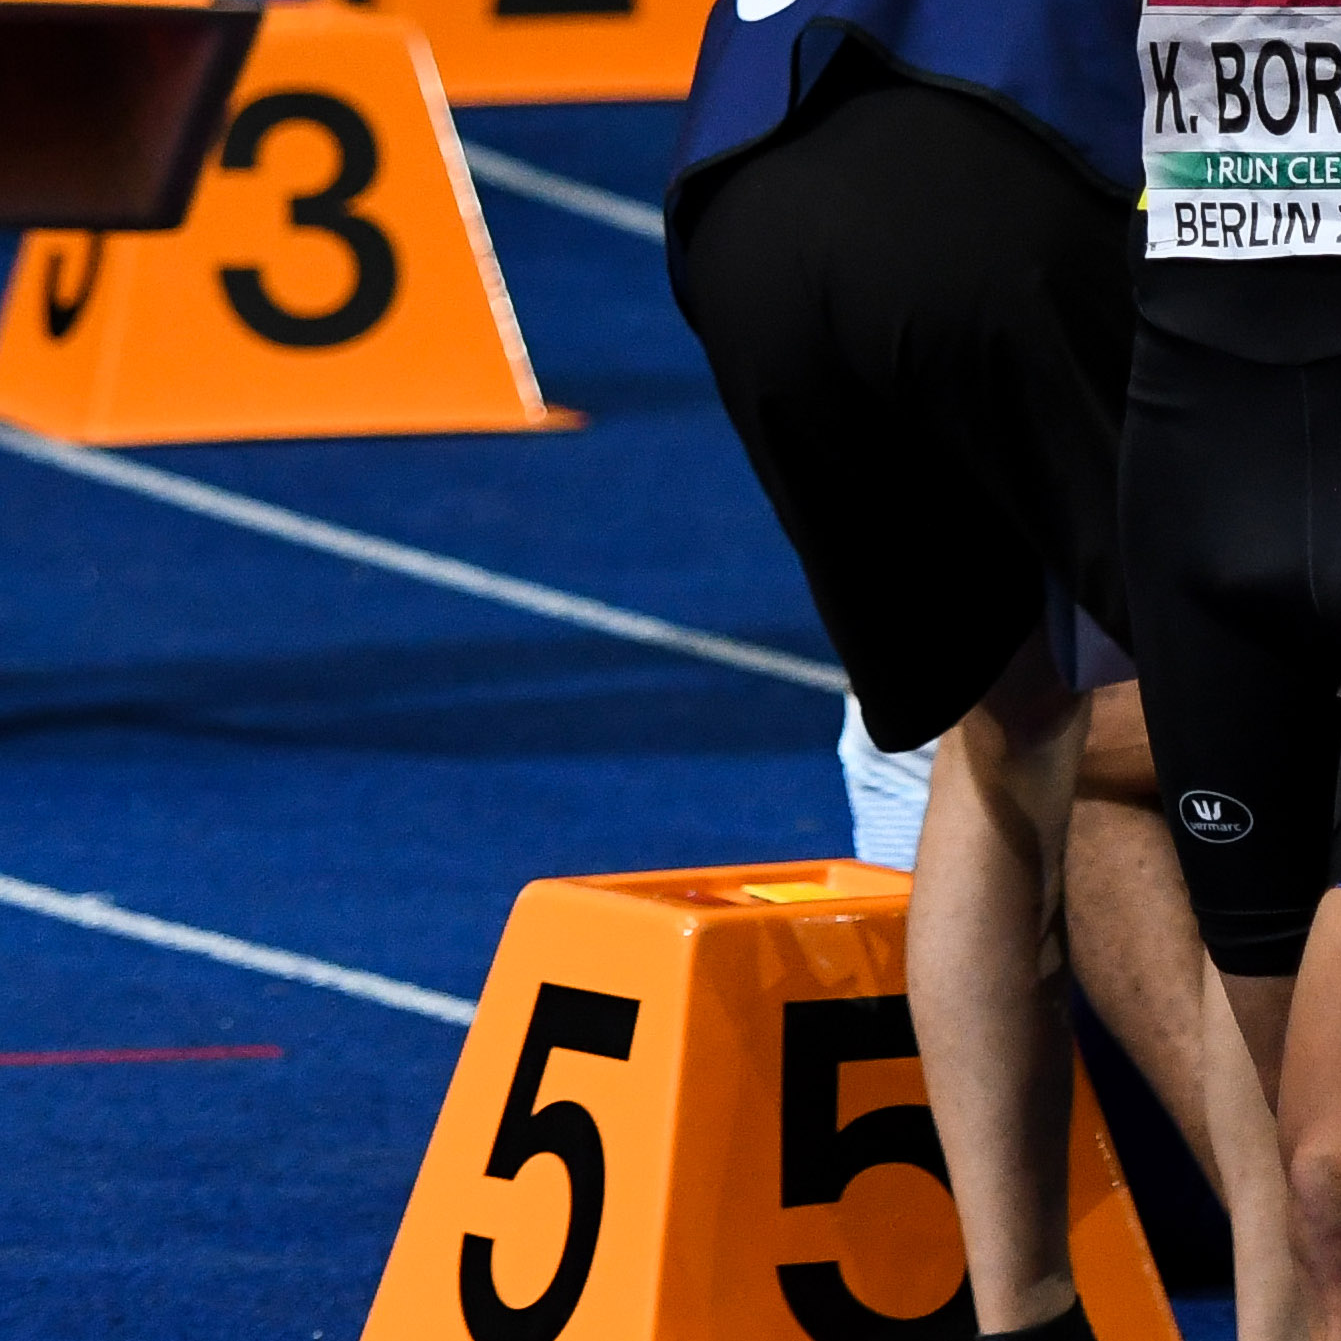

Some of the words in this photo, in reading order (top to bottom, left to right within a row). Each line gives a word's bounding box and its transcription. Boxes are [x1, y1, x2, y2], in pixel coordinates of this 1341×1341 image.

[1148, 40, 1199, 135] K.
[1205, 158, 1213, 184] I
[1221, 158, 1278, 185] RUN
[217, 90, 400, 347] 3
[1174, 201, 1321, 248] BERLIN
[459, 982, 641, 1341] 5
[776, 994, 975, 1341] 5
